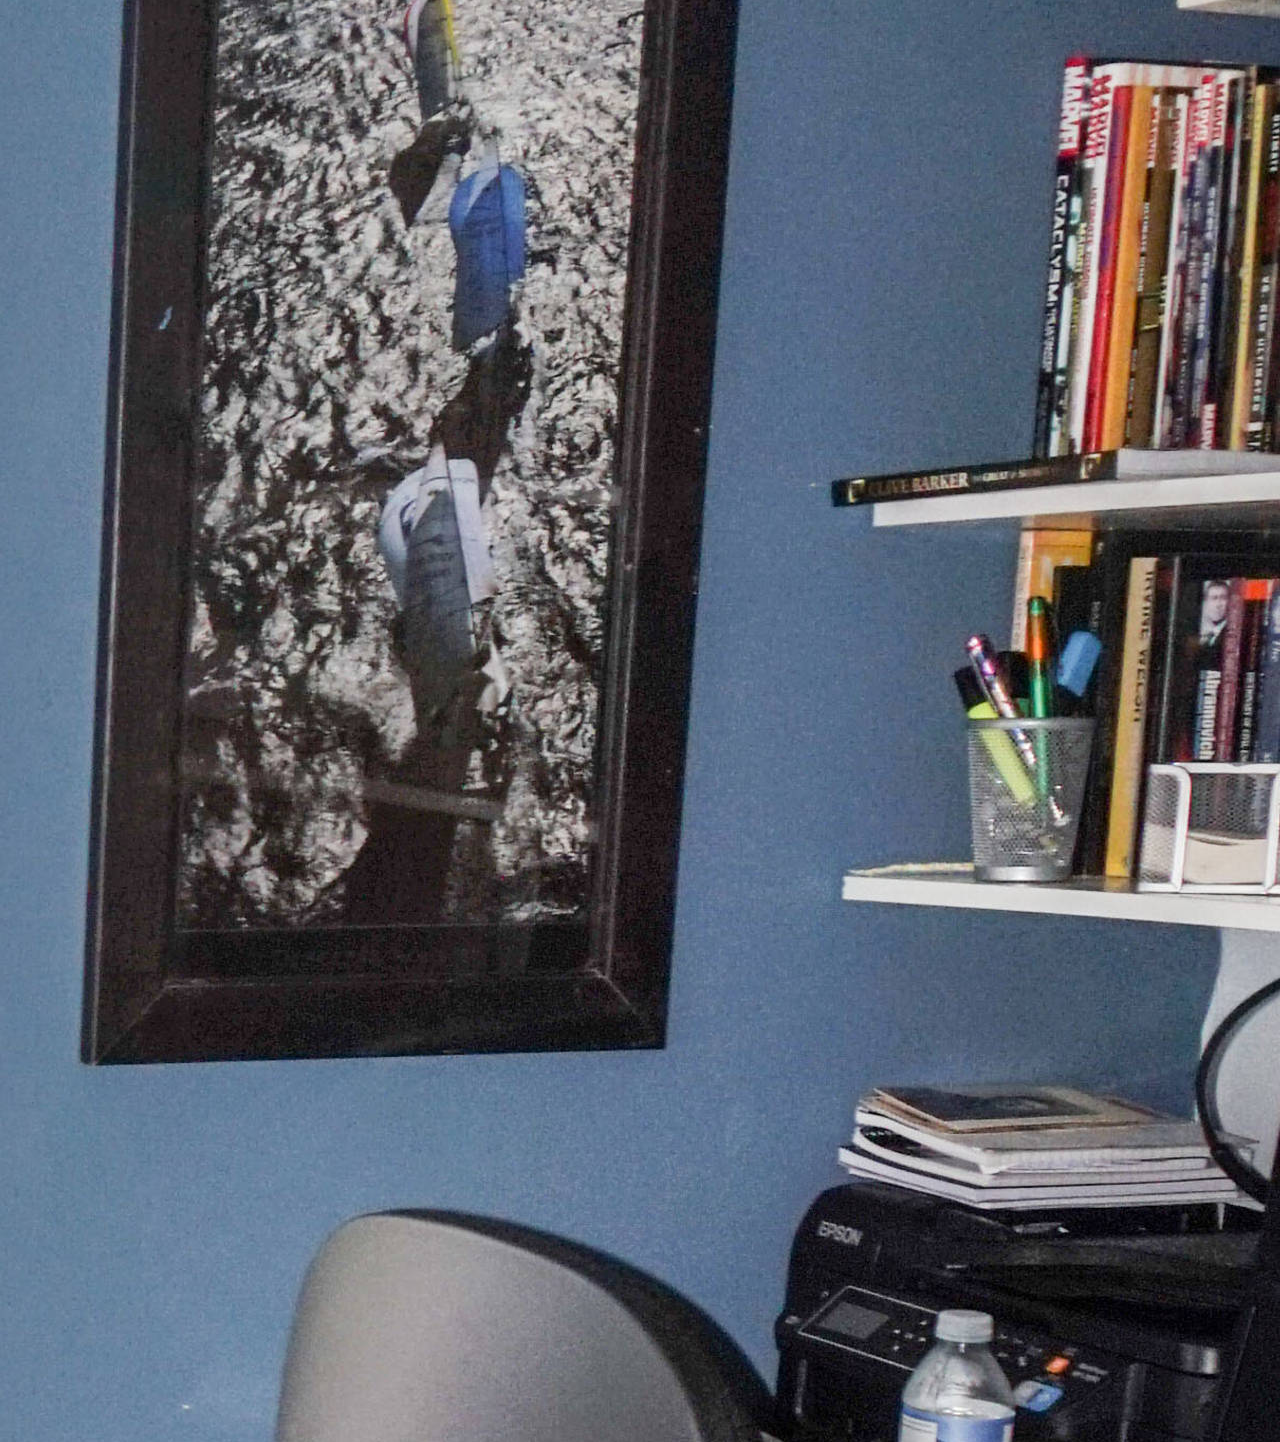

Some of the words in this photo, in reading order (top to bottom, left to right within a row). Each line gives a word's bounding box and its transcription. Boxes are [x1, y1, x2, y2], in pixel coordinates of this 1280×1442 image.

[1058, 65, 1086, 150] MARVEL
[912, 472, 970, 493] BARKER
[1199, 669, 1222, 761] Abramovich
[817, 1220, 864, 1247] EPSON
